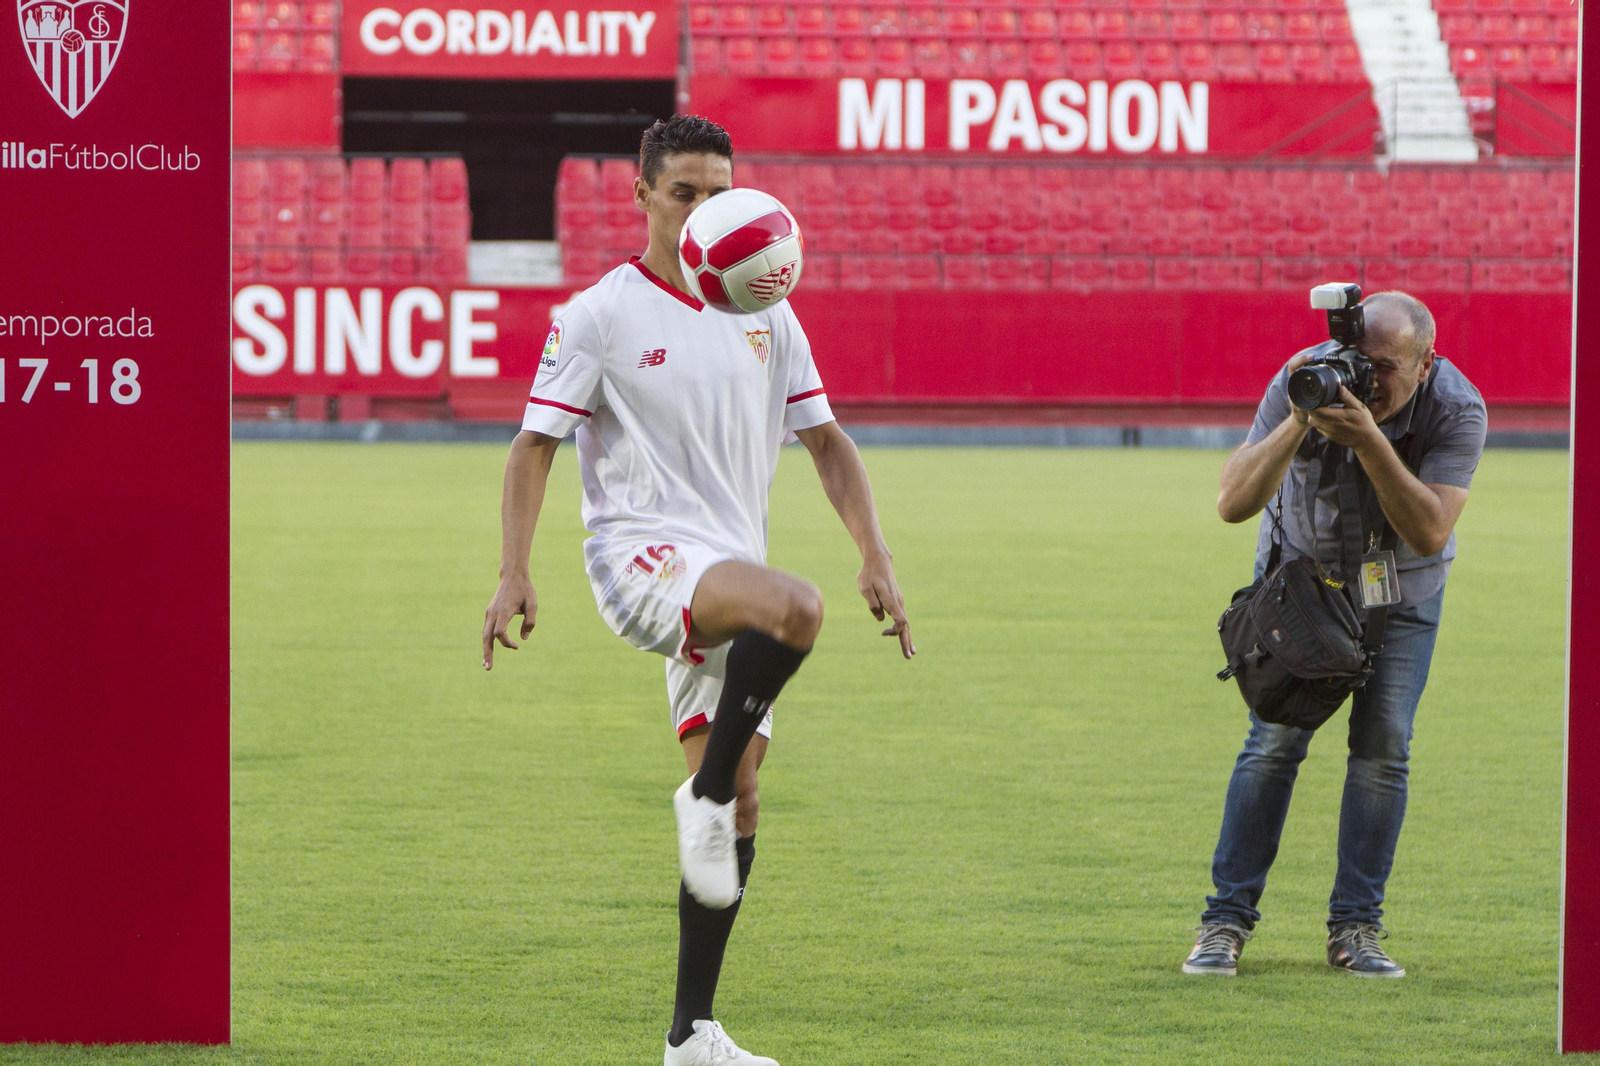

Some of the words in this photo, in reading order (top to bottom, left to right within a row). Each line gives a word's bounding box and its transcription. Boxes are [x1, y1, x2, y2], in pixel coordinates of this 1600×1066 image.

[360, 8, 656, 55] CORDIALITY
[838, 78, 925, 150] MI
[949, 79, 1209, 152] PASION
[233, 285, 500, 378] SINCE
